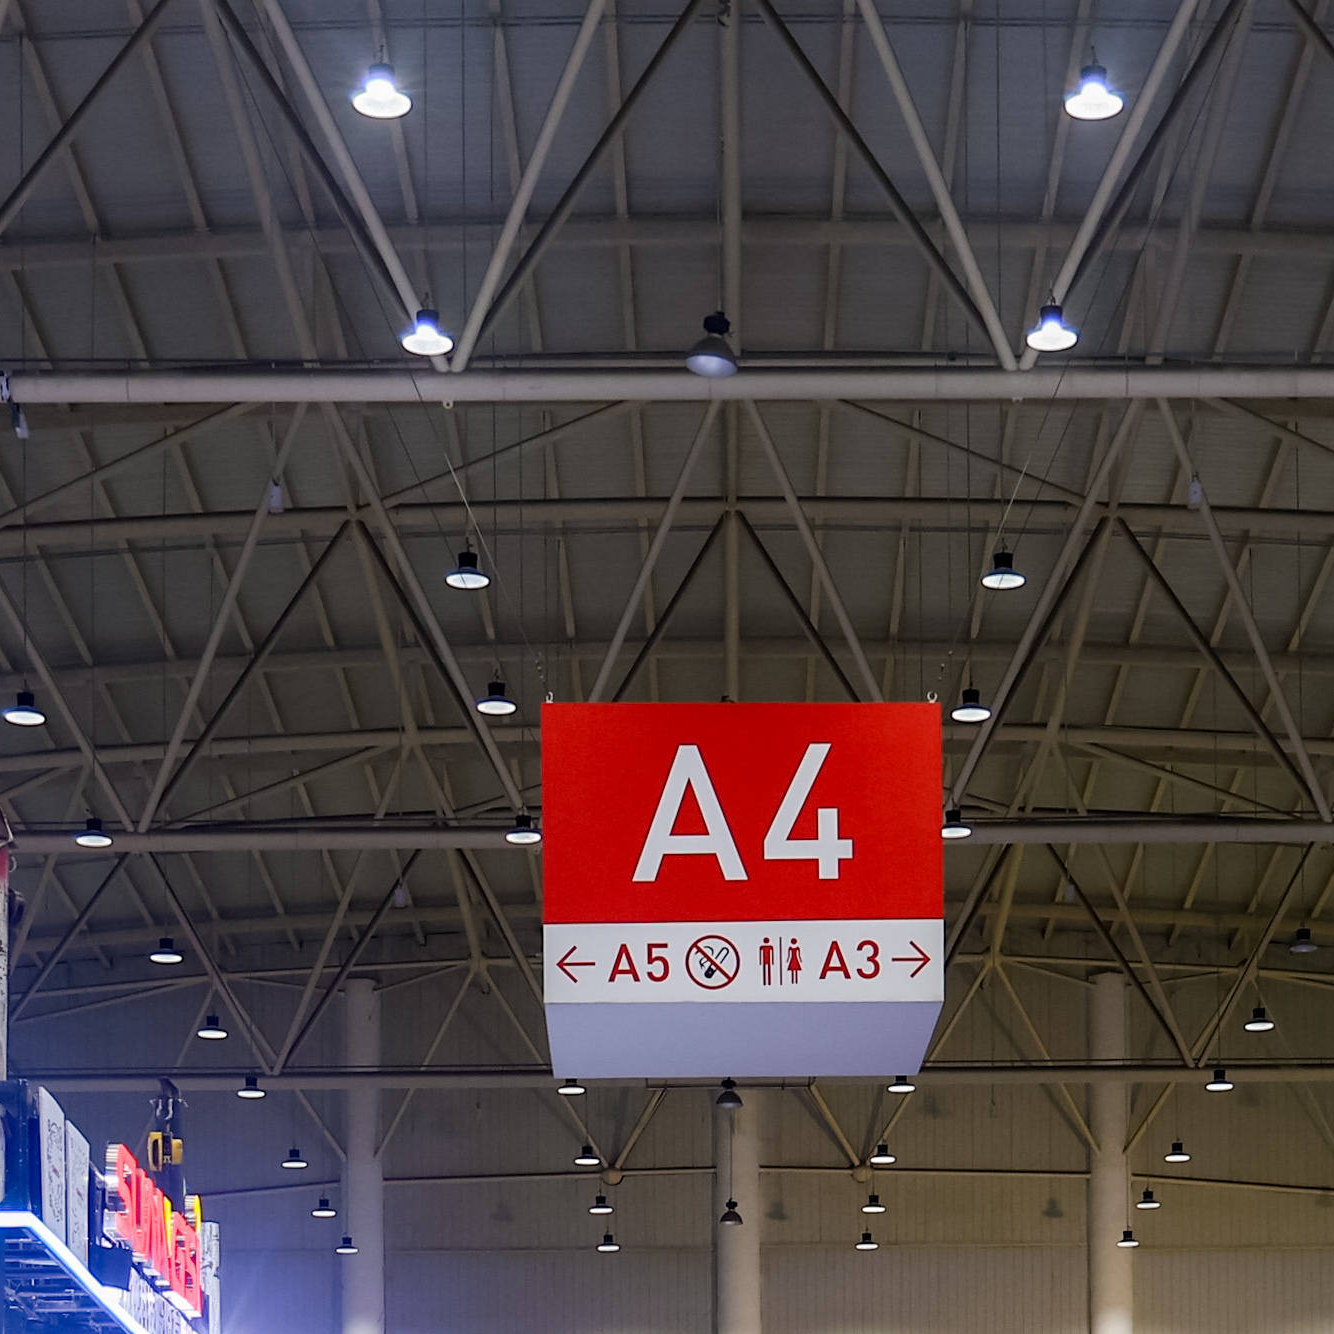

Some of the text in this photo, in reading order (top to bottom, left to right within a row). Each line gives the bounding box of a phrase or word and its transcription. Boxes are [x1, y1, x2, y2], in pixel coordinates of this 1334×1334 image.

[632, 742, 854, 882] A4
[608, 940, 881, 983] A5 A3
